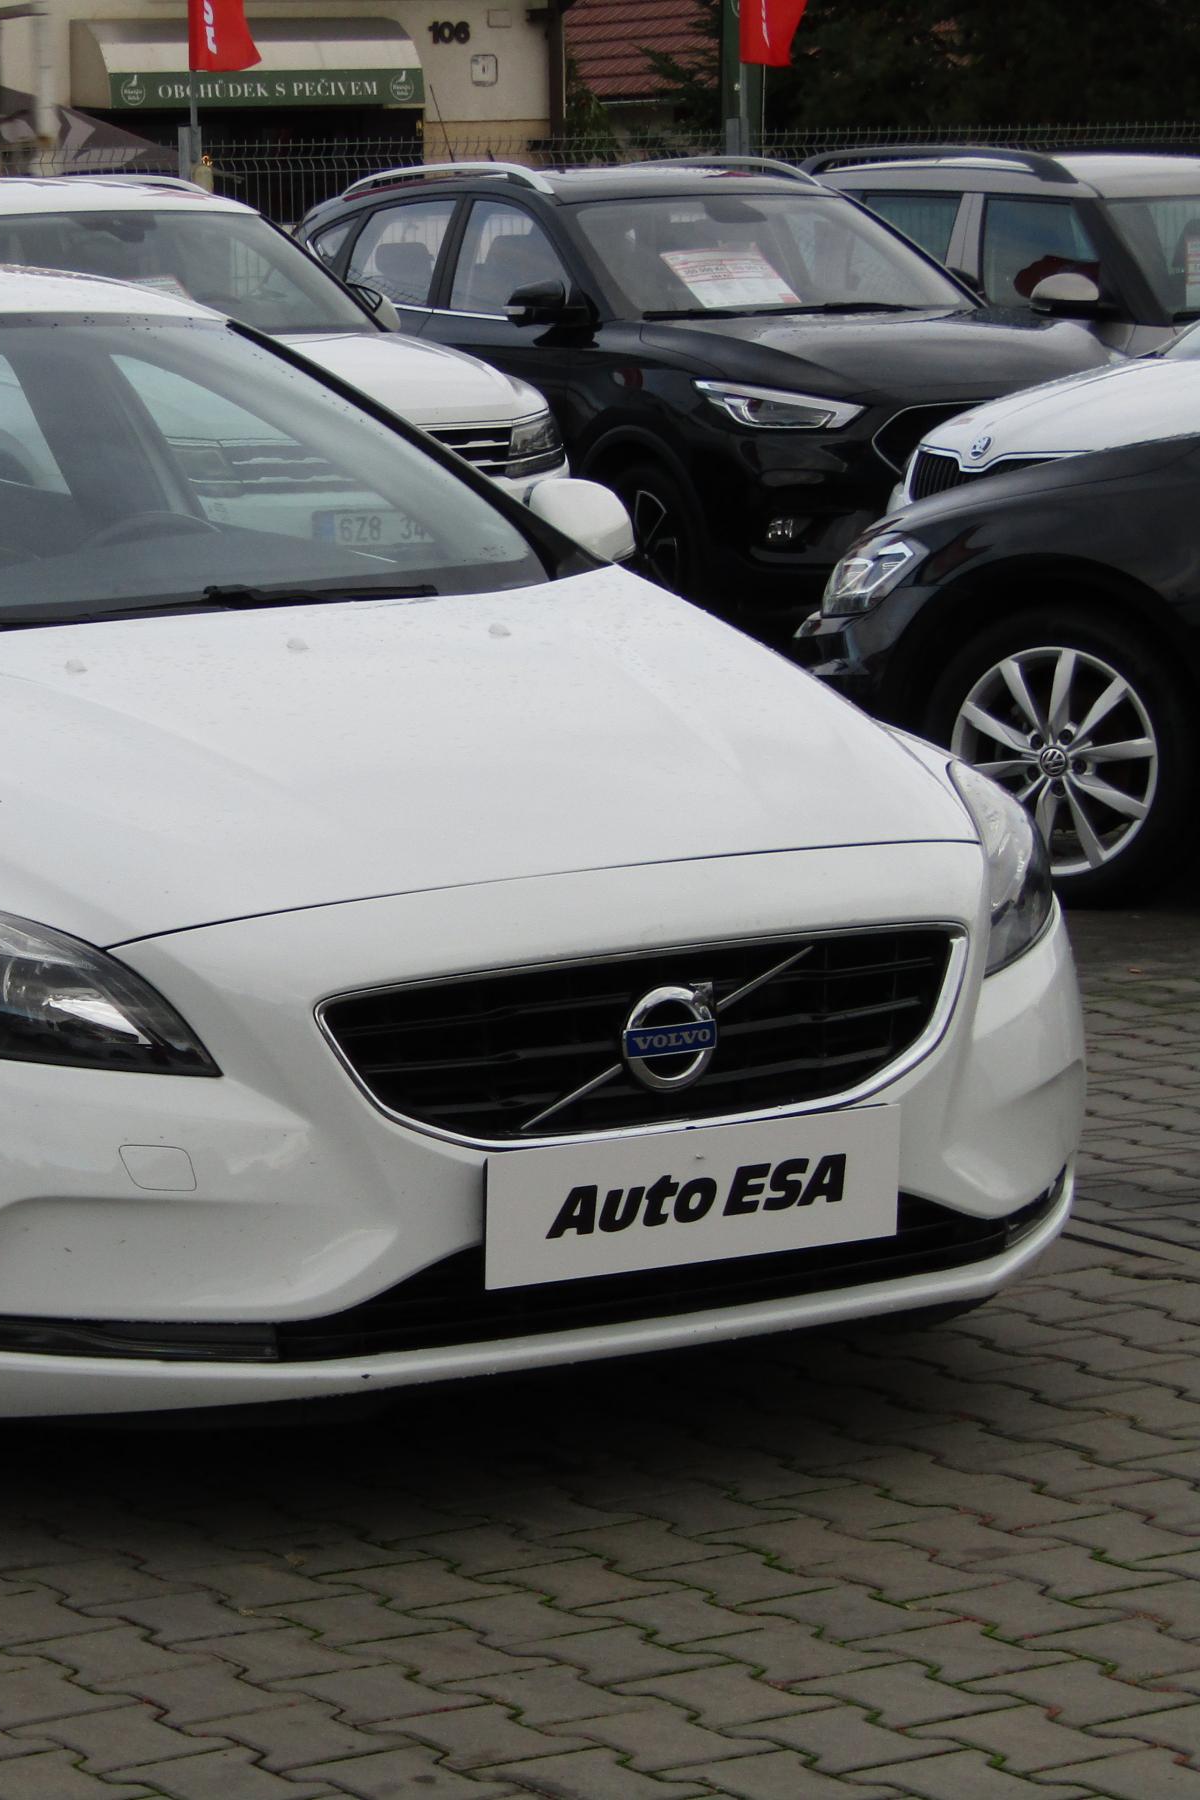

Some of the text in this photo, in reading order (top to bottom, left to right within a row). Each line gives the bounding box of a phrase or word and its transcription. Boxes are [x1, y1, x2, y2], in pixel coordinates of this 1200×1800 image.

[428, 21, 470, 44] 106
[275, 82, 286, 97] S
[293, 79, 378, 97] PEČIVEM
[632, 1028, 711, 1050] VOLVO
[545, 1153, 847, 1240] Auto ESA
